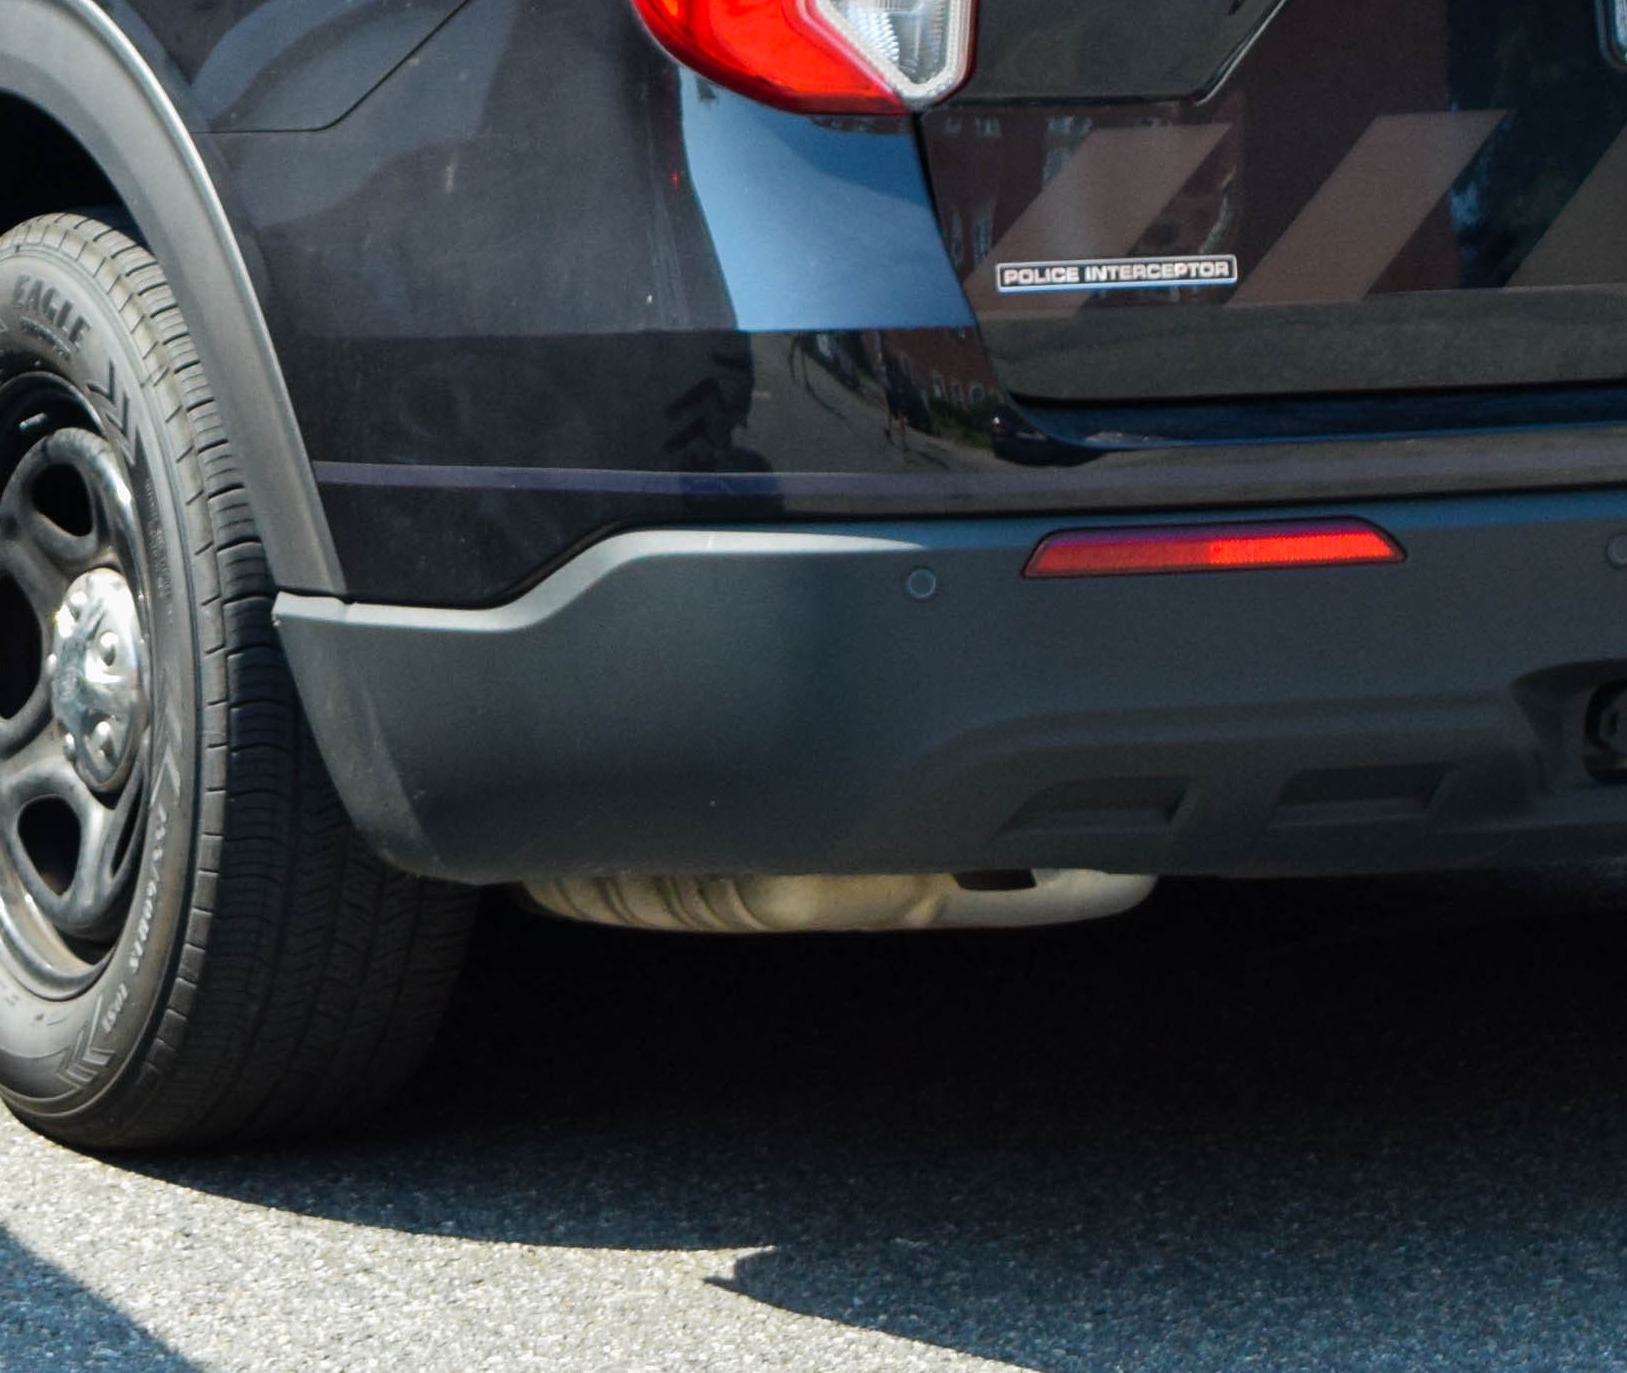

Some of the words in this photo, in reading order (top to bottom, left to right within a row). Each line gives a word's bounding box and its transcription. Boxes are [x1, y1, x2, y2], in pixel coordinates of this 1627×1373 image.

[1004, 267, 1079, 285] POLICE
[1085, 261, 1229, 282] INTERCEPTOR
[12, 275, 91, 353] EAGLE
